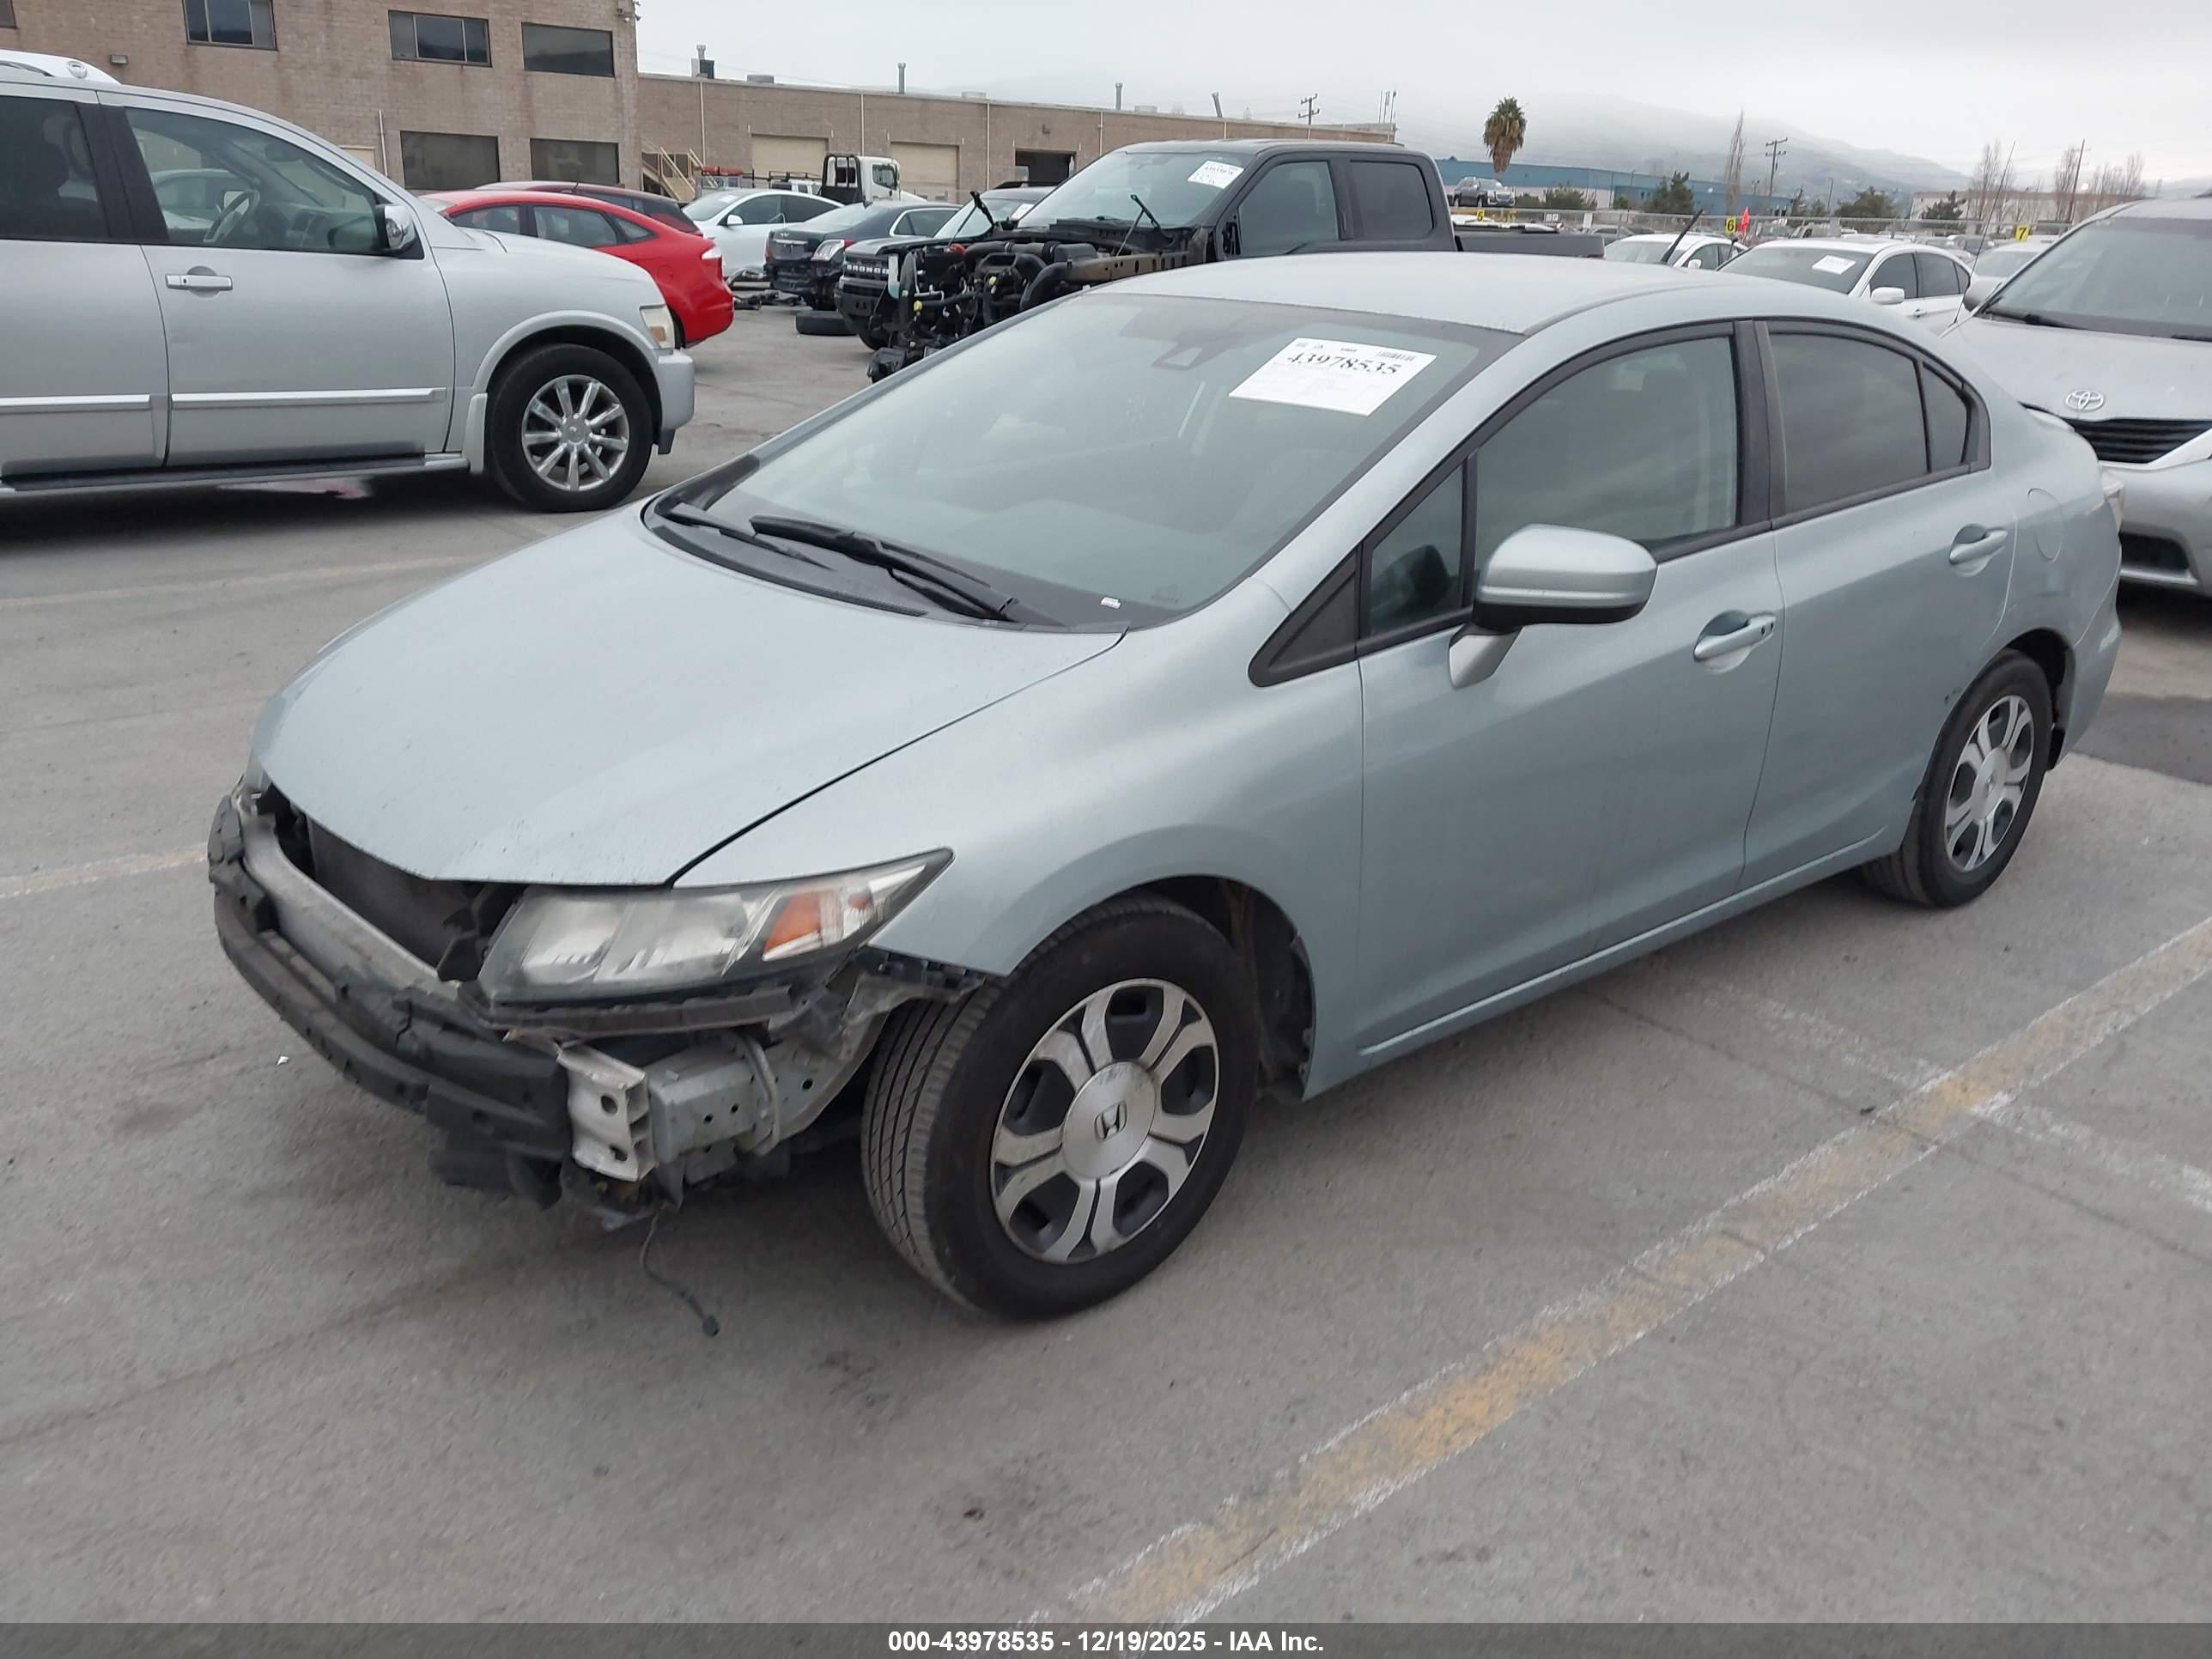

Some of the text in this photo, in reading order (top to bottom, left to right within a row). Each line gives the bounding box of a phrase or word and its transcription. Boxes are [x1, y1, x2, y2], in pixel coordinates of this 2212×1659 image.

[1727, 219, 1735, 232] 6
[2019, 227, 2027, 241] 7
[1287, 352, 1402, 374] 43978535
